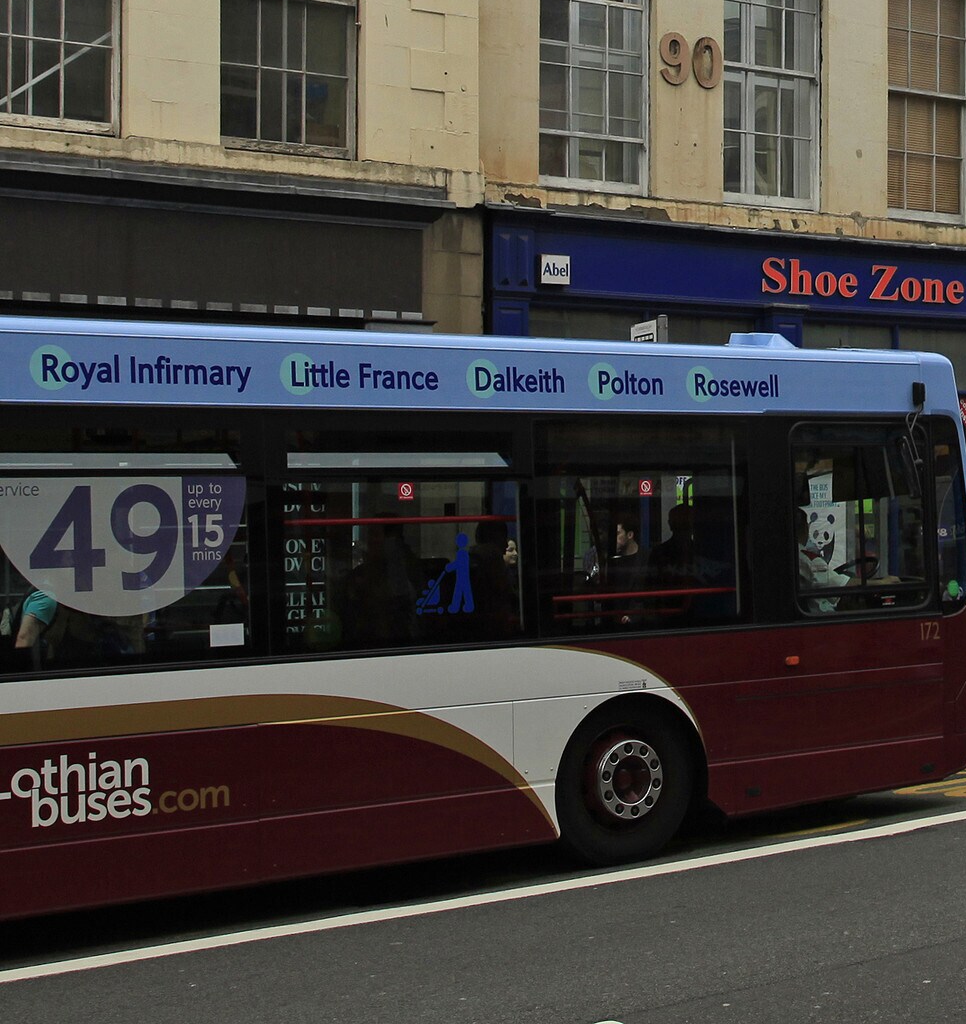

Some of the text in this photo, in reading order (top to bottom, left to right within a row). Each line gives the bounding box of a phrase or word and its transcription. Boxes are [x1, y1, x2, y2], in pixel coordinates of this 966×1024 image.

[659, 32, 723, 90] 90
[543, 262, 569, 277] Abel
[761, 257, 965, 305] Shoe Zone
[41, 353, 252, 393] Royal Infirmary
[291, 360, 439, 391] Little France
[474, 366, 565, 393] Dalkeith
[598, 370, 664, 396] Polton
[694, 373, 780, 398] Rosewell
[187, 483, 222, 497] up to
[188, 498, 222, 511] every
[29, 484, 179, 592] 49
[187, 514, 224, 548] 15
[192, 548, 222, 561] mins
[920, 622, 940, 640] 172
